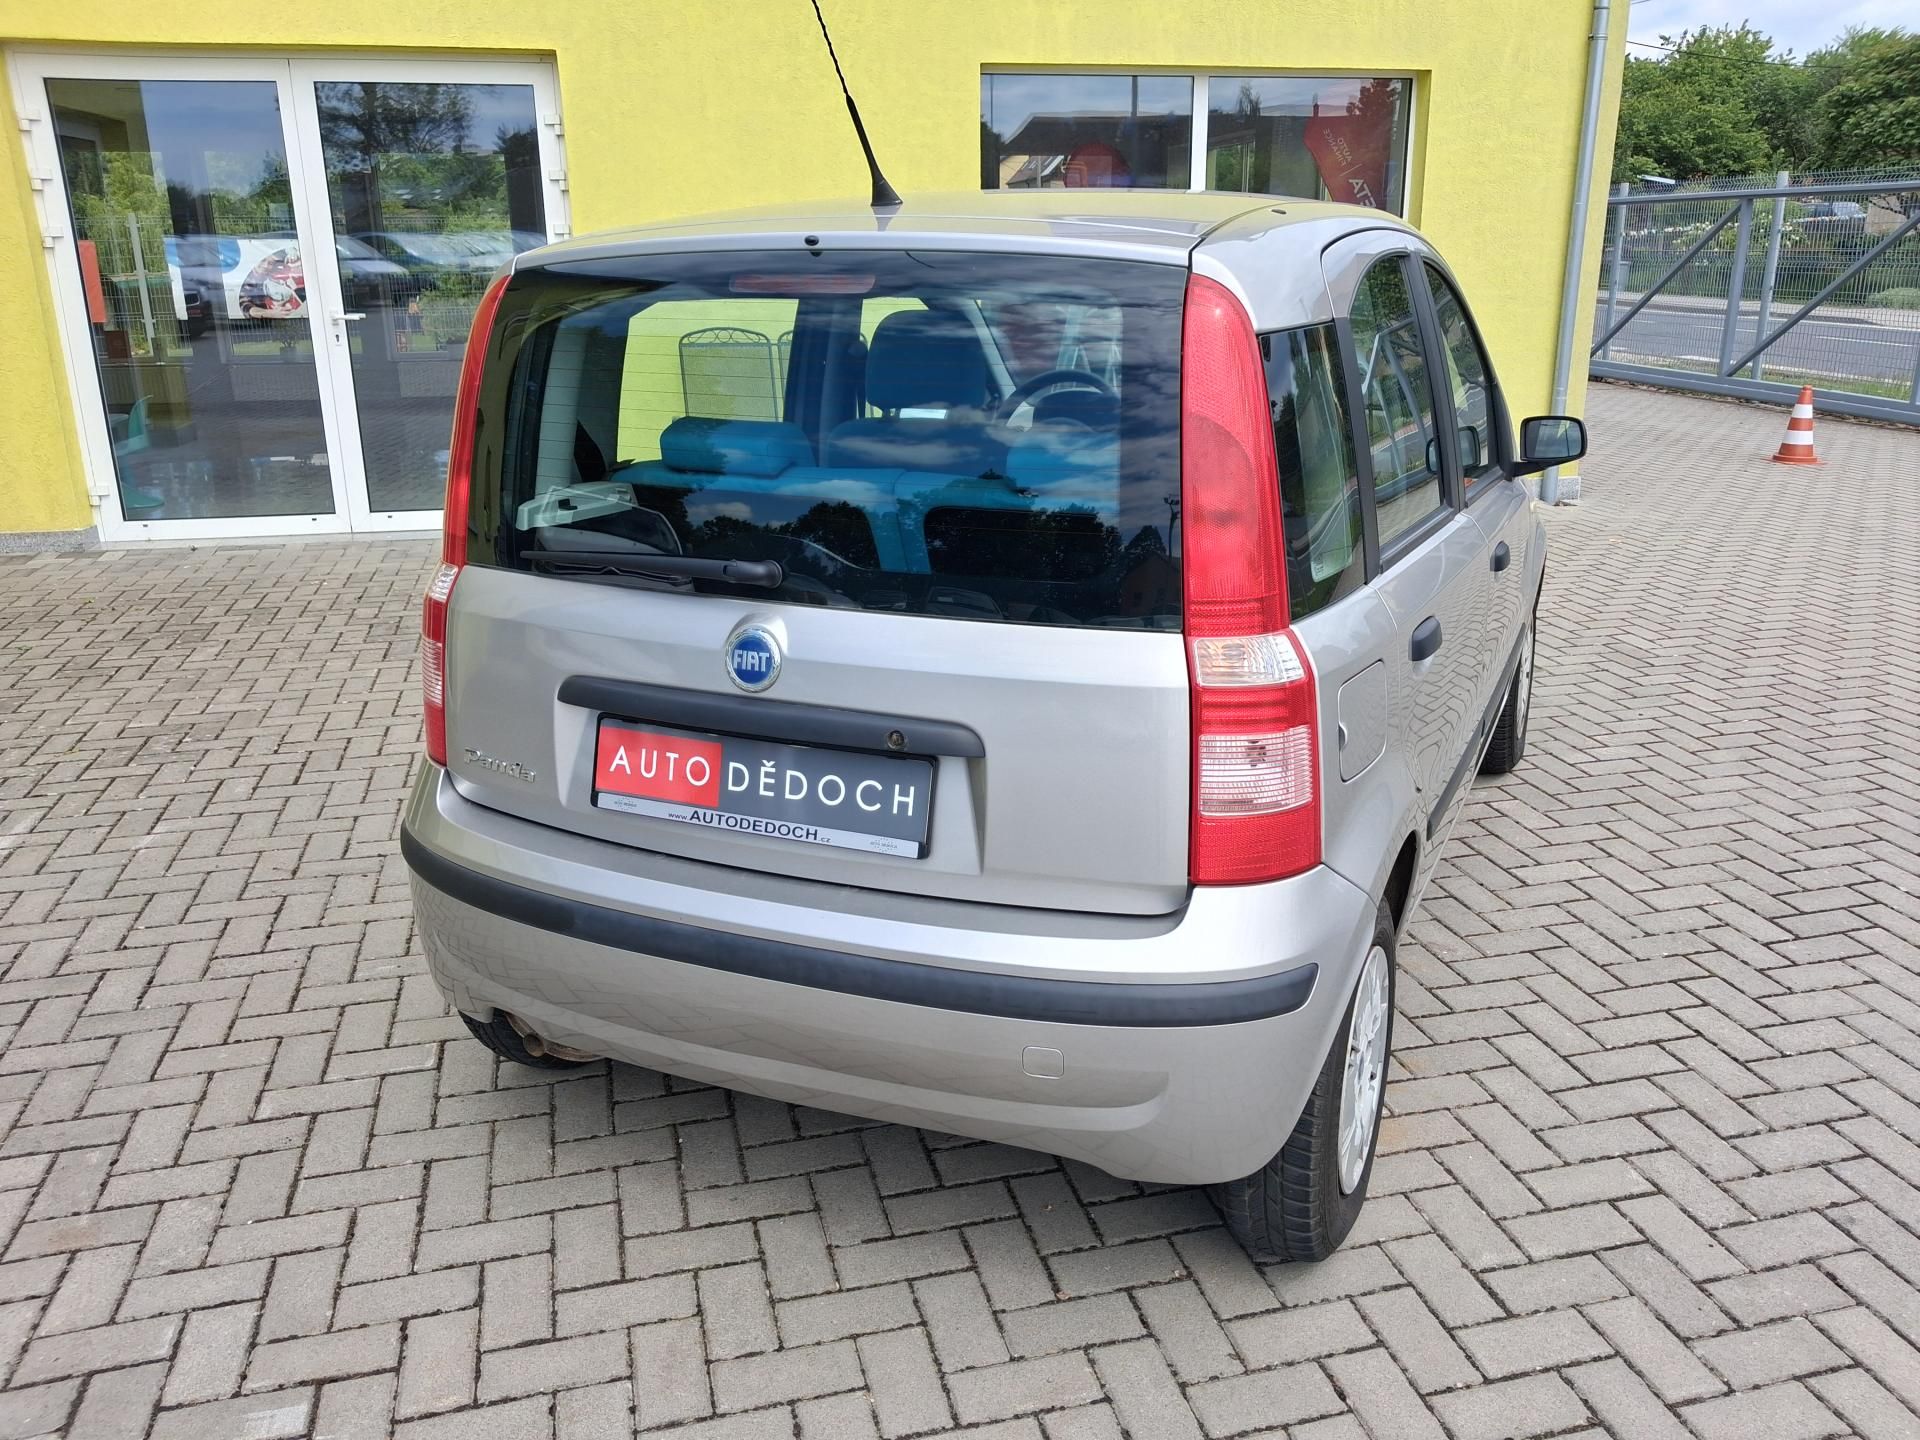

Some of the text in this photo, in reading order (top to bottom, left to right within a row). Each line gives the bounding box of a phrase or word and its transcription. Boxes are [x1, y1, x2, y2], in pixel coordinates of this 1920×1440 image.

[733, 649, 770, 672] FIAT
[464, 747, 536, 783] Panda
[609, 745, 915, 817] AUTO DĚDOCH
